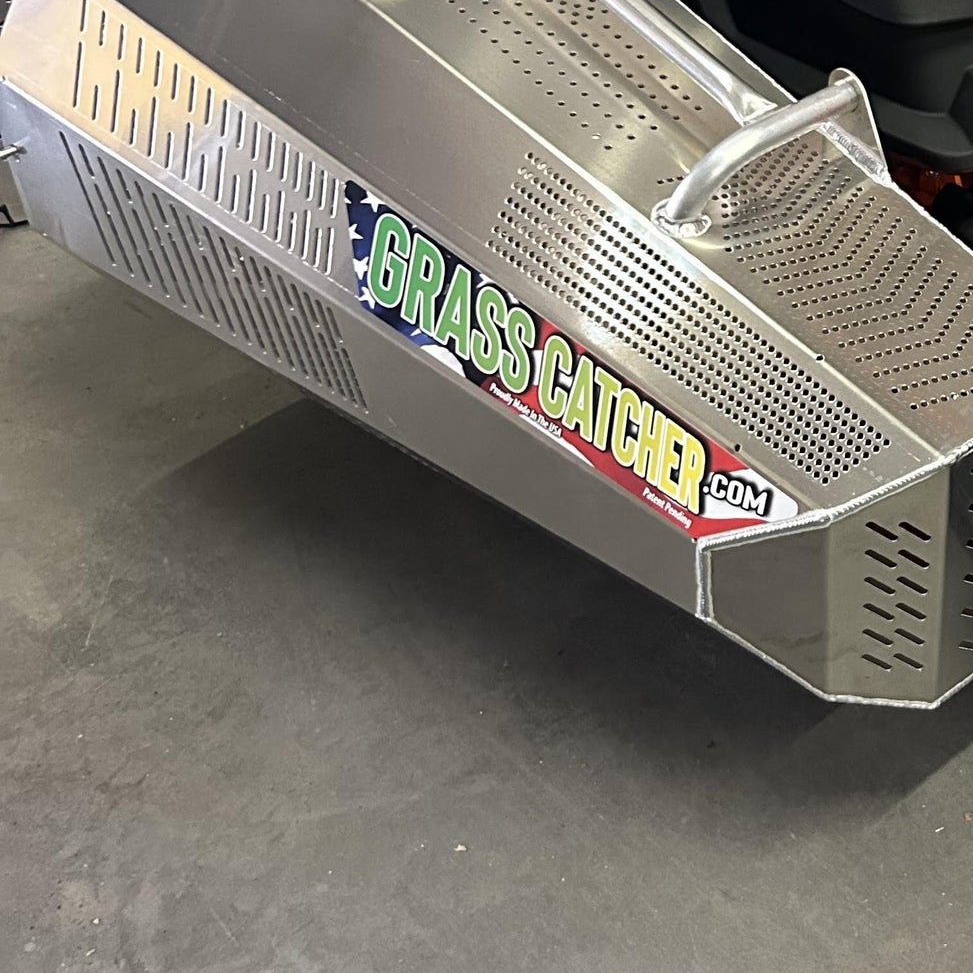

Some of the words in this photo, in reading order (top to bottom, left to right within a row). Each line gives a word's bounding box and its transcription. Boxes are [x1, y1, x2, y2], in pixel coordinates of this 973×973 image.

[367, 212, 536, 394] GRASS
[489, 382, 514, 406] Proudly
[511, 397, 531, 416] Made
[529, 409, 538, 421] In
[537, 413, 549, 428] The
[548, 421, 563, 438] USA
[642, 486, 666, 509] Patent
[664, 501, 693, 530] Pending
